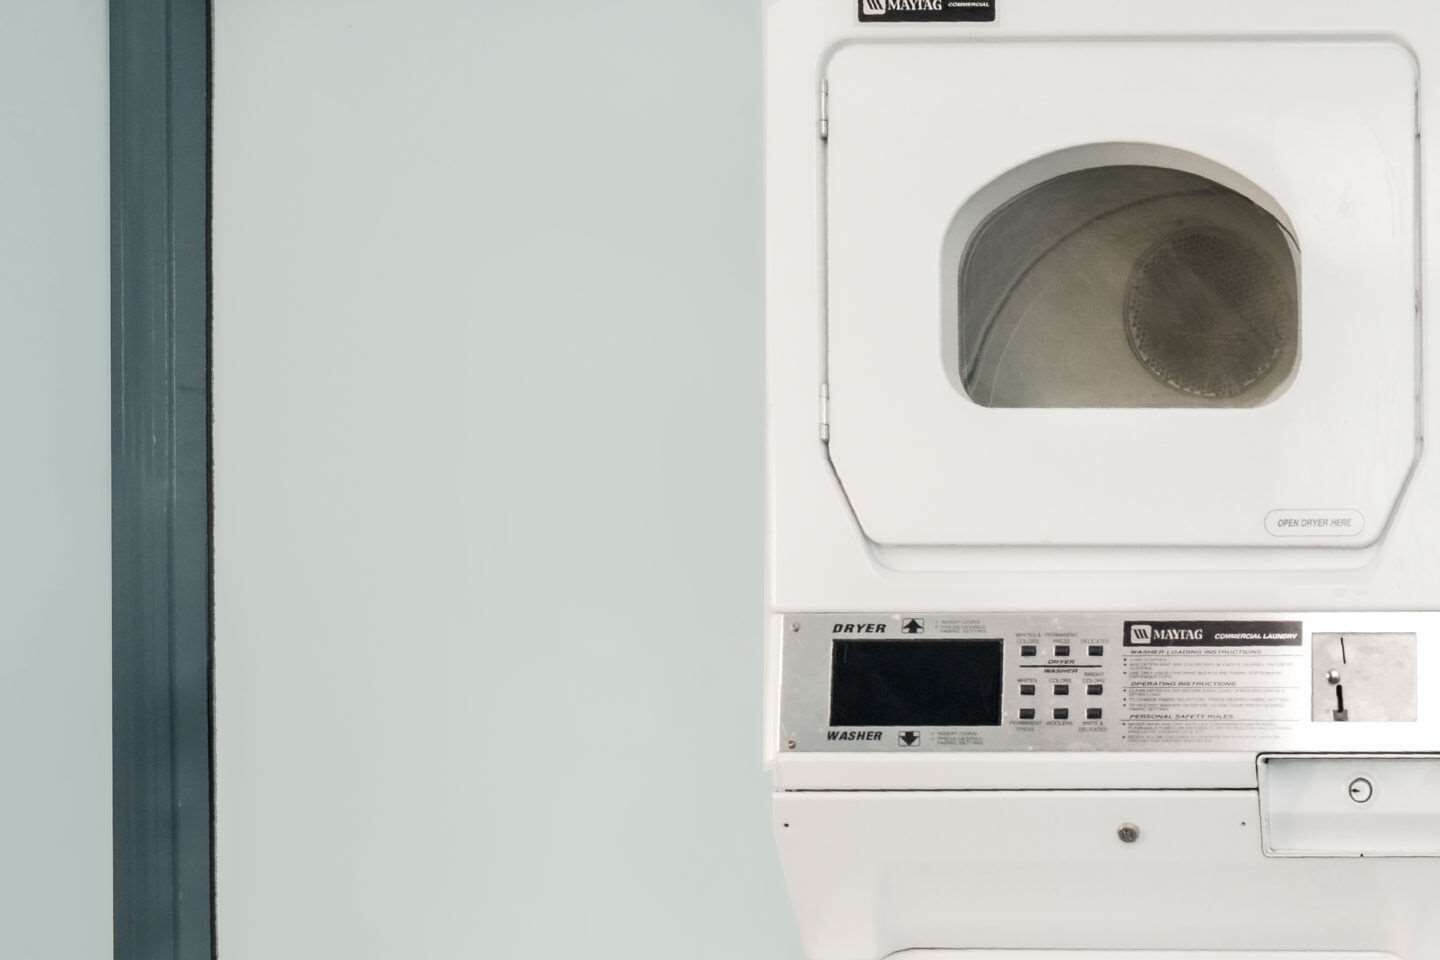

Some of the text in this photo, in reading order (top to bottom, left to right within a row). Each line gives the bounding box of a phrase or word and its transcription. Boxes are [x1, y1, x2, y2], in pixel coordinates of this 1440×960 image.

[887, 0, 943, 11] MAYTAG
[1277, 518, 1353, 528] OPEN DRYER HERE
[832, 622, 887, 634] DRYER
[1153, 629, 1298, 640] MAYTAG COMMERCIAL LAUNDRY
[827, 731, 883, 742] WASHER
